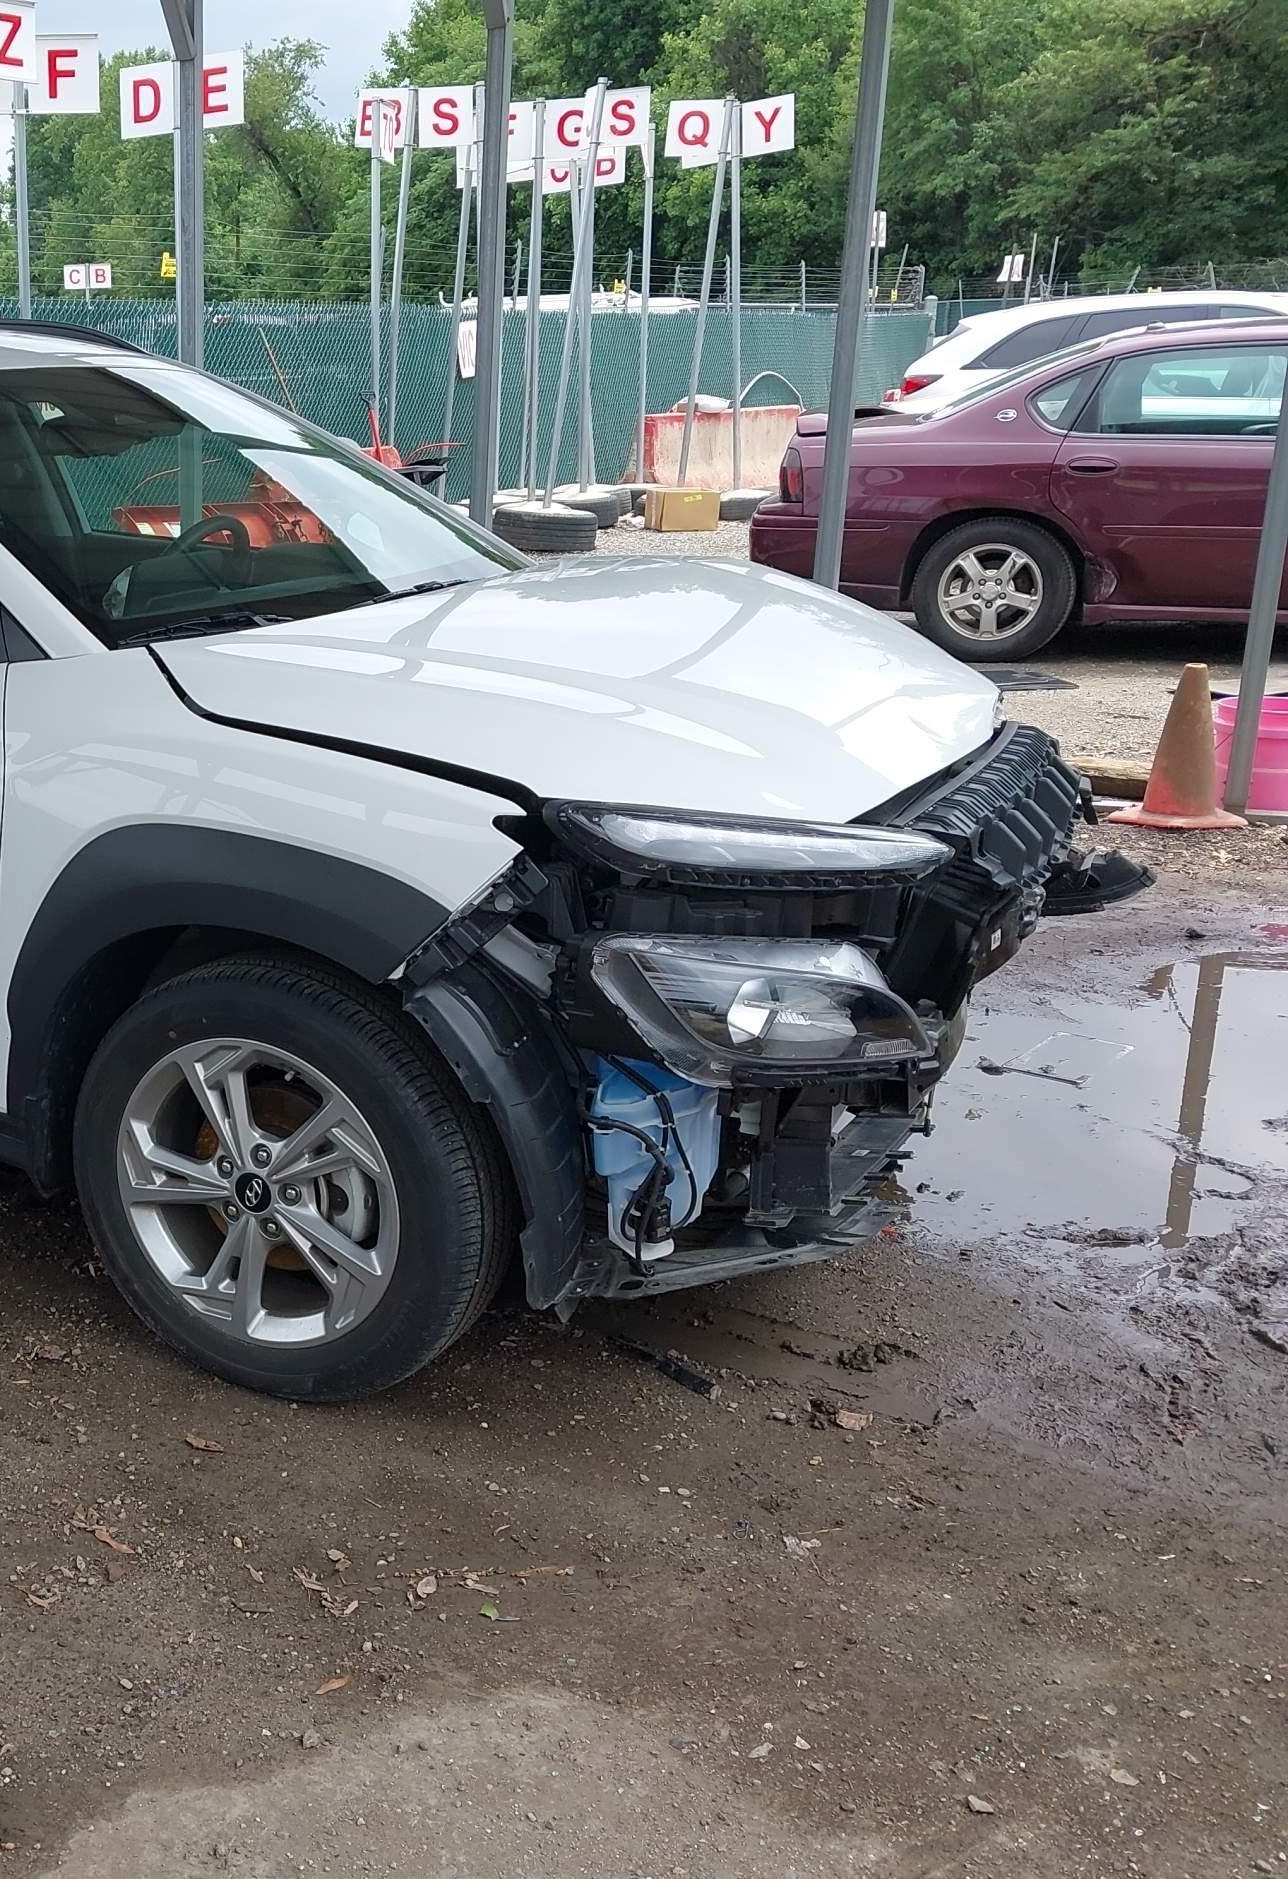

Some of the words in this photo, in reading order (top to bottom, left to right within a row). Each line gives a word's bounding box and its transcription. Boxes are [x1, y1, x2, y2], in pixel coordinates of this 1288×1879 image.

[47, 49, 79, 99] F
[203, 66, 228, 114] E
[133, 78, 161, 124] D
[432, 98, 460, 136] S
[610, 99, 636, 136] S
[557, 109, 584, 147] G
[678, 110, 710, 148] Q
[754, 105, 782, 143] Y
[69, 269, 81, 284] C
[95, 268, 106, 284] B
